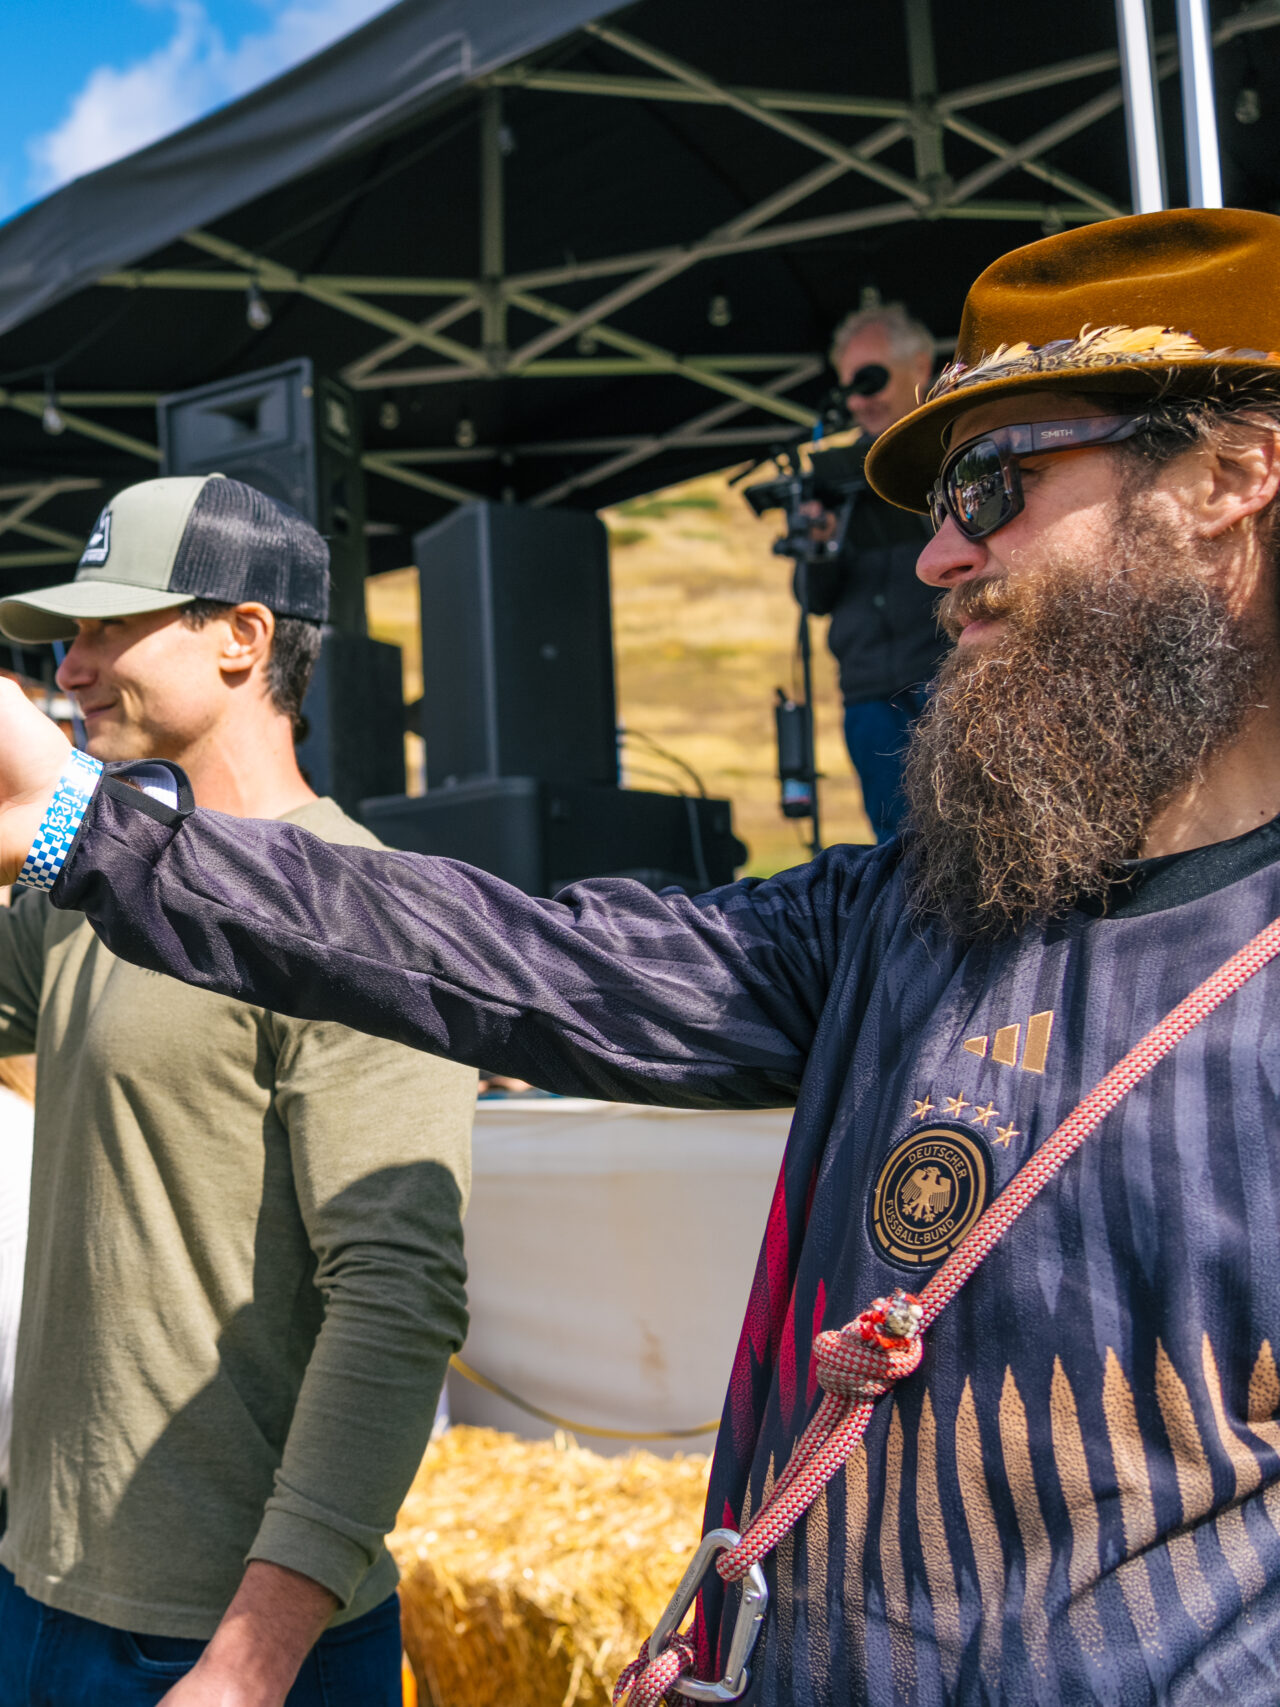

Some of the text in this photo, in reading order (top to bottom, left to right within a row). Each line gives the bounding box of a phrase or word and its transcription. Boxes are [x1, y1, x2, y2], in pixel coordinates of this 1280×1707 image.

[1040, 429, 1073, 440] SMITH
[908, 1146, 968, 1180] DEUTSCHER
[886, 1200, 955, 1244] FUSSBALL-BUND
